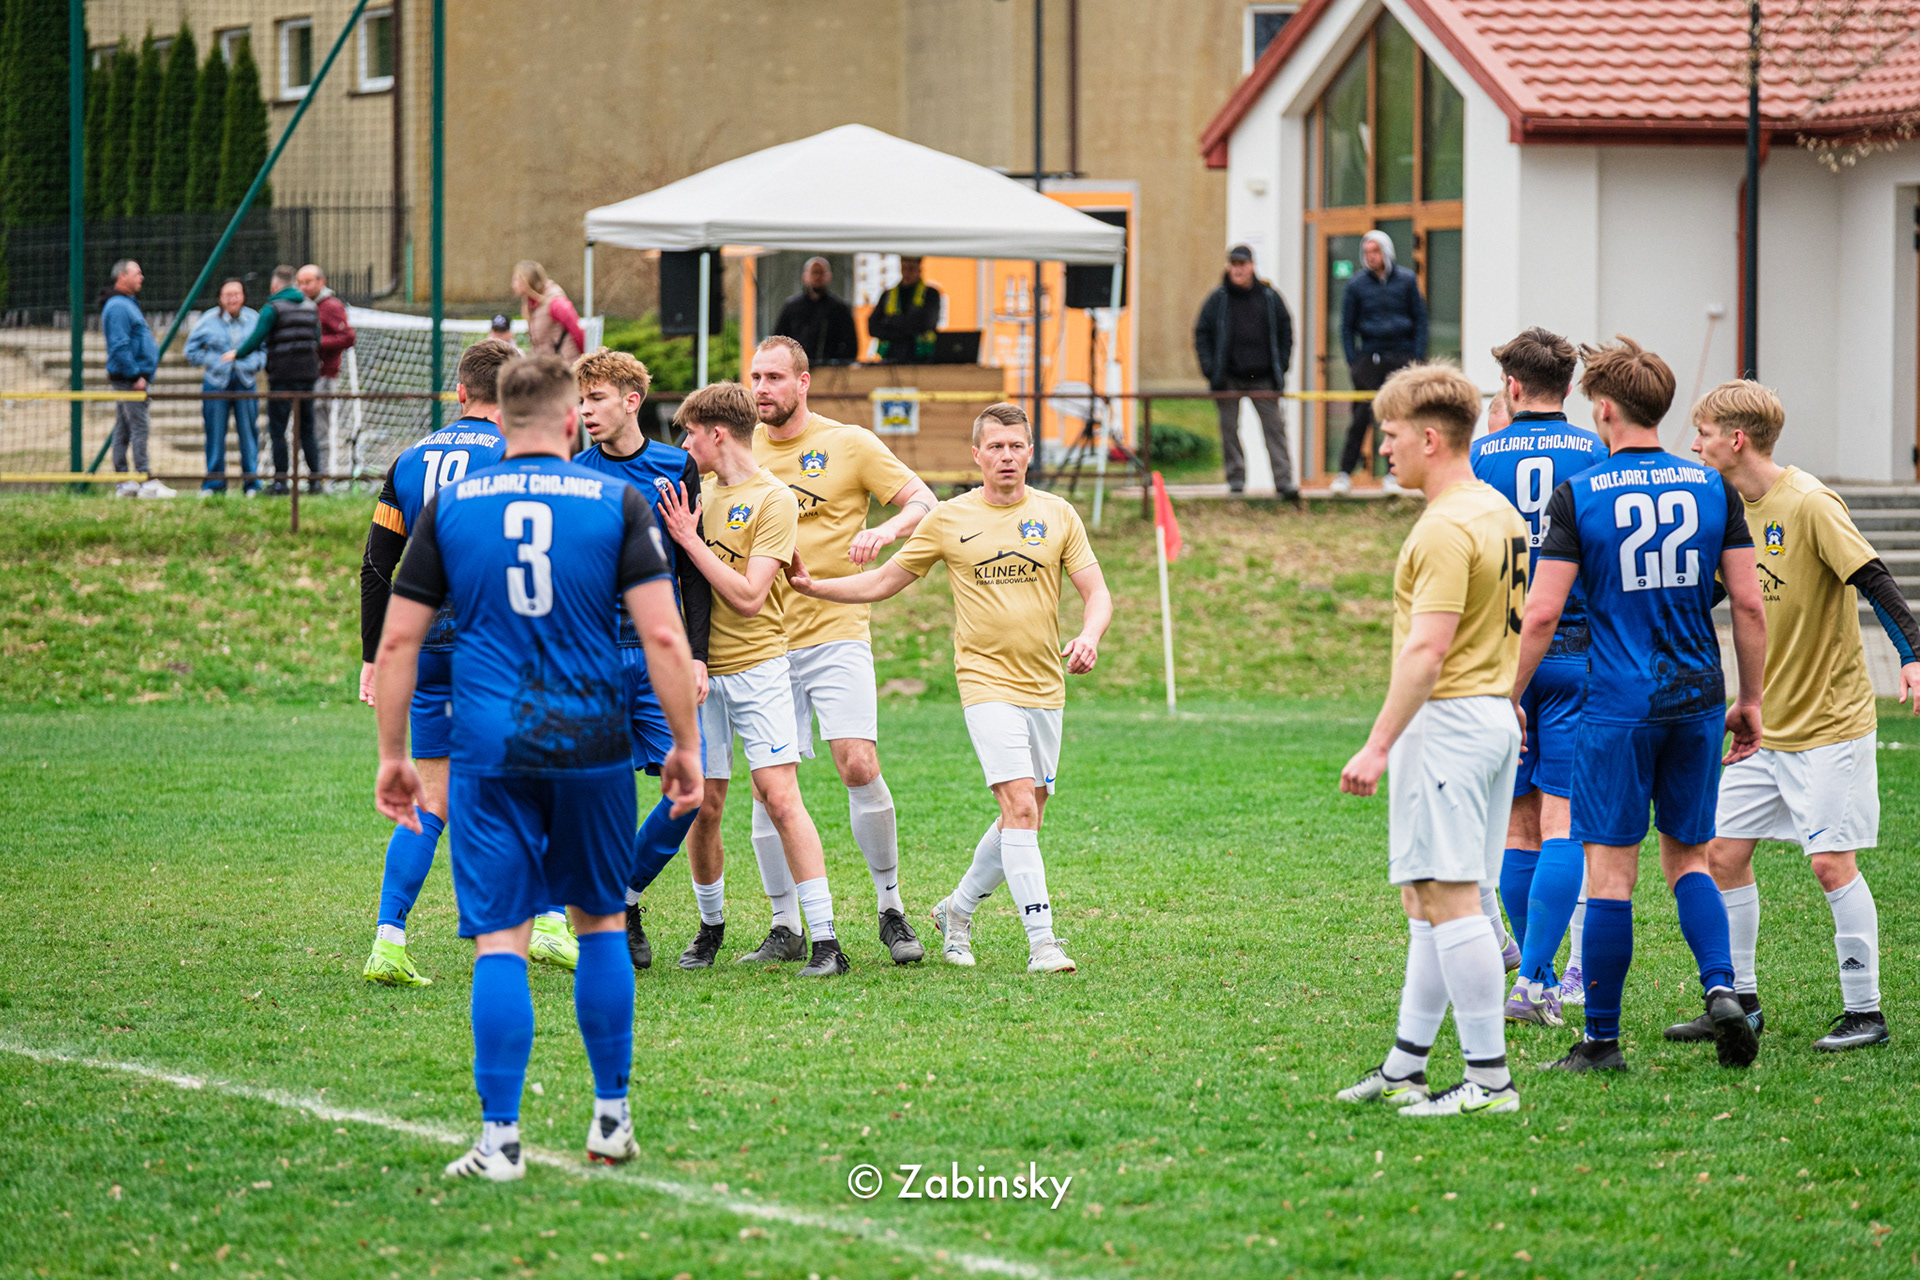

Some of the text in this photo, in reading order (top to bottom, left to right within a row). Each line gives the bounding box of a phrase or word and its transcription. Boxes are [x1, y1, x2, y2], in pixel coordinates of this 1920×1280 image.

[414, 432, 500, 449] LEJARZ CHOJNICE
[1480, 434, 1594, 456] KOLEJARZ CHOJNICE
[456, 473, 603, 500] KOLEJARZ CHOJNICE
[1590, 466, 1708, 492] KOLEJARZ CHOJNICE
[1516, 456, 1554, 548] 9
[1614, 490, 1700, 592] 22
[503, 500, 554, 618] 3
[974, 563, 1028, 579] KLINEK
[995, 576, 1038, 585] BUDOWLANA
[1500, 536, 1527, 637] 15
